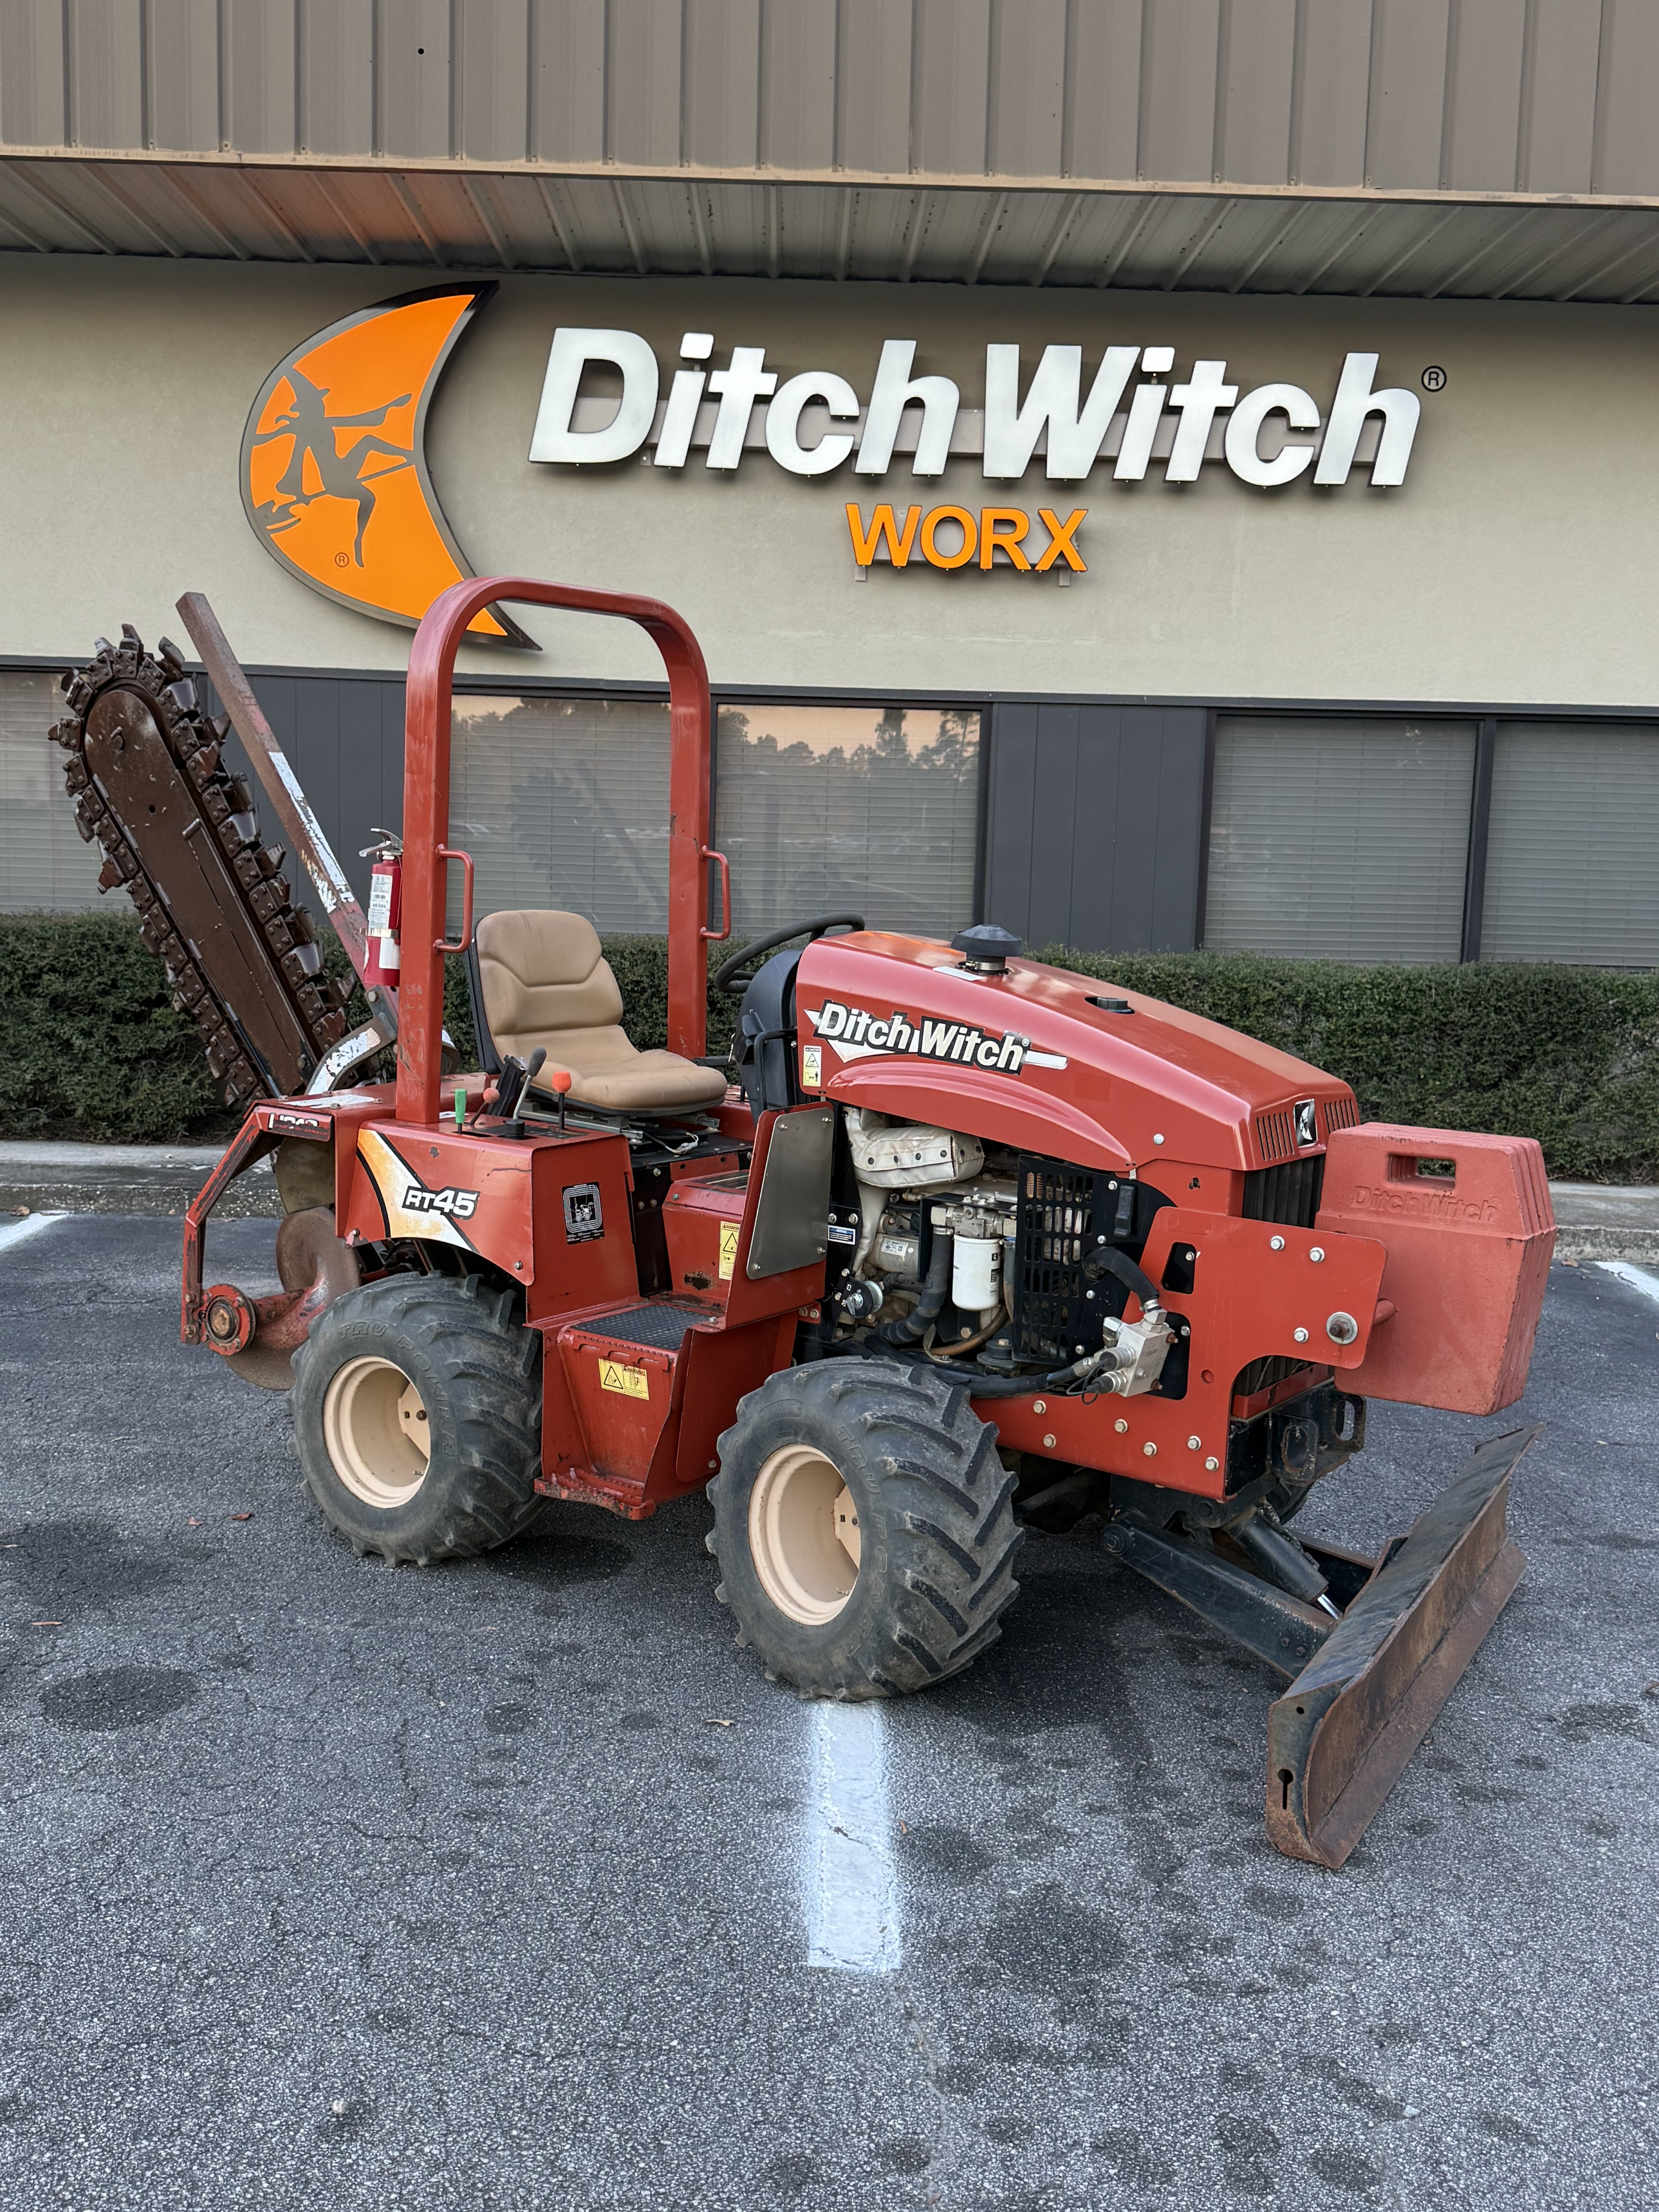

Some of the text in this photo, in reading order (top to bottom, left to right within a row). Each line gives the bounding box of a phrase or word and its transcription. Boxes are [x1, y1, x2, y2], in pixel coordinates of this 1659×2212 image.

[528, 327, 960, 476] Ditch
[846, 503, 1089, 572] WORX
[817, 1003, 912, 1050] Ditch
[405, 1189, 478, 1217] RT45
[1350, 1186, 1420, 1214] Ditch
[338, 1321, 389, 1339] TRU
